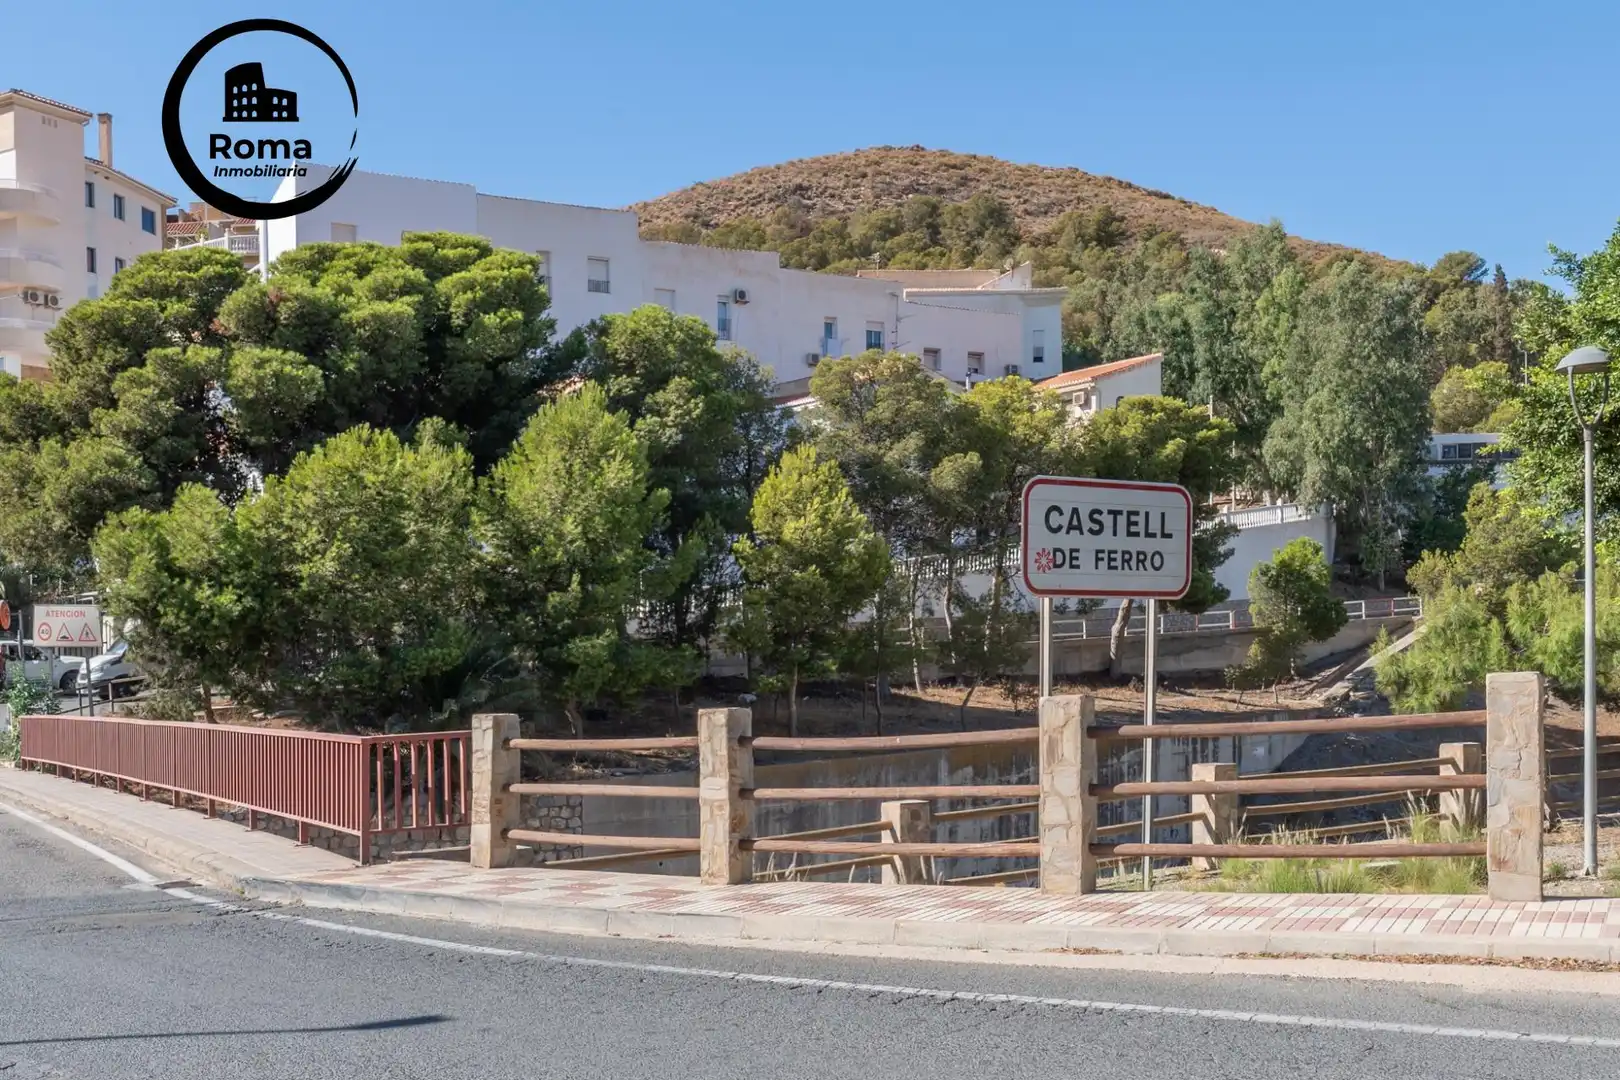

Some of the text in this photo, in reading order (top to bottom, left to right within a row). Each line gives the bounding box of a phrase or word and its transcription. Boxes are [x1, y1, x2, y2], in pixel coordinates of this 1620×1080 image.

[1044, 504, 1173, 539] CASTELL
[1052, 547, 1165, 572] DE FERRO
